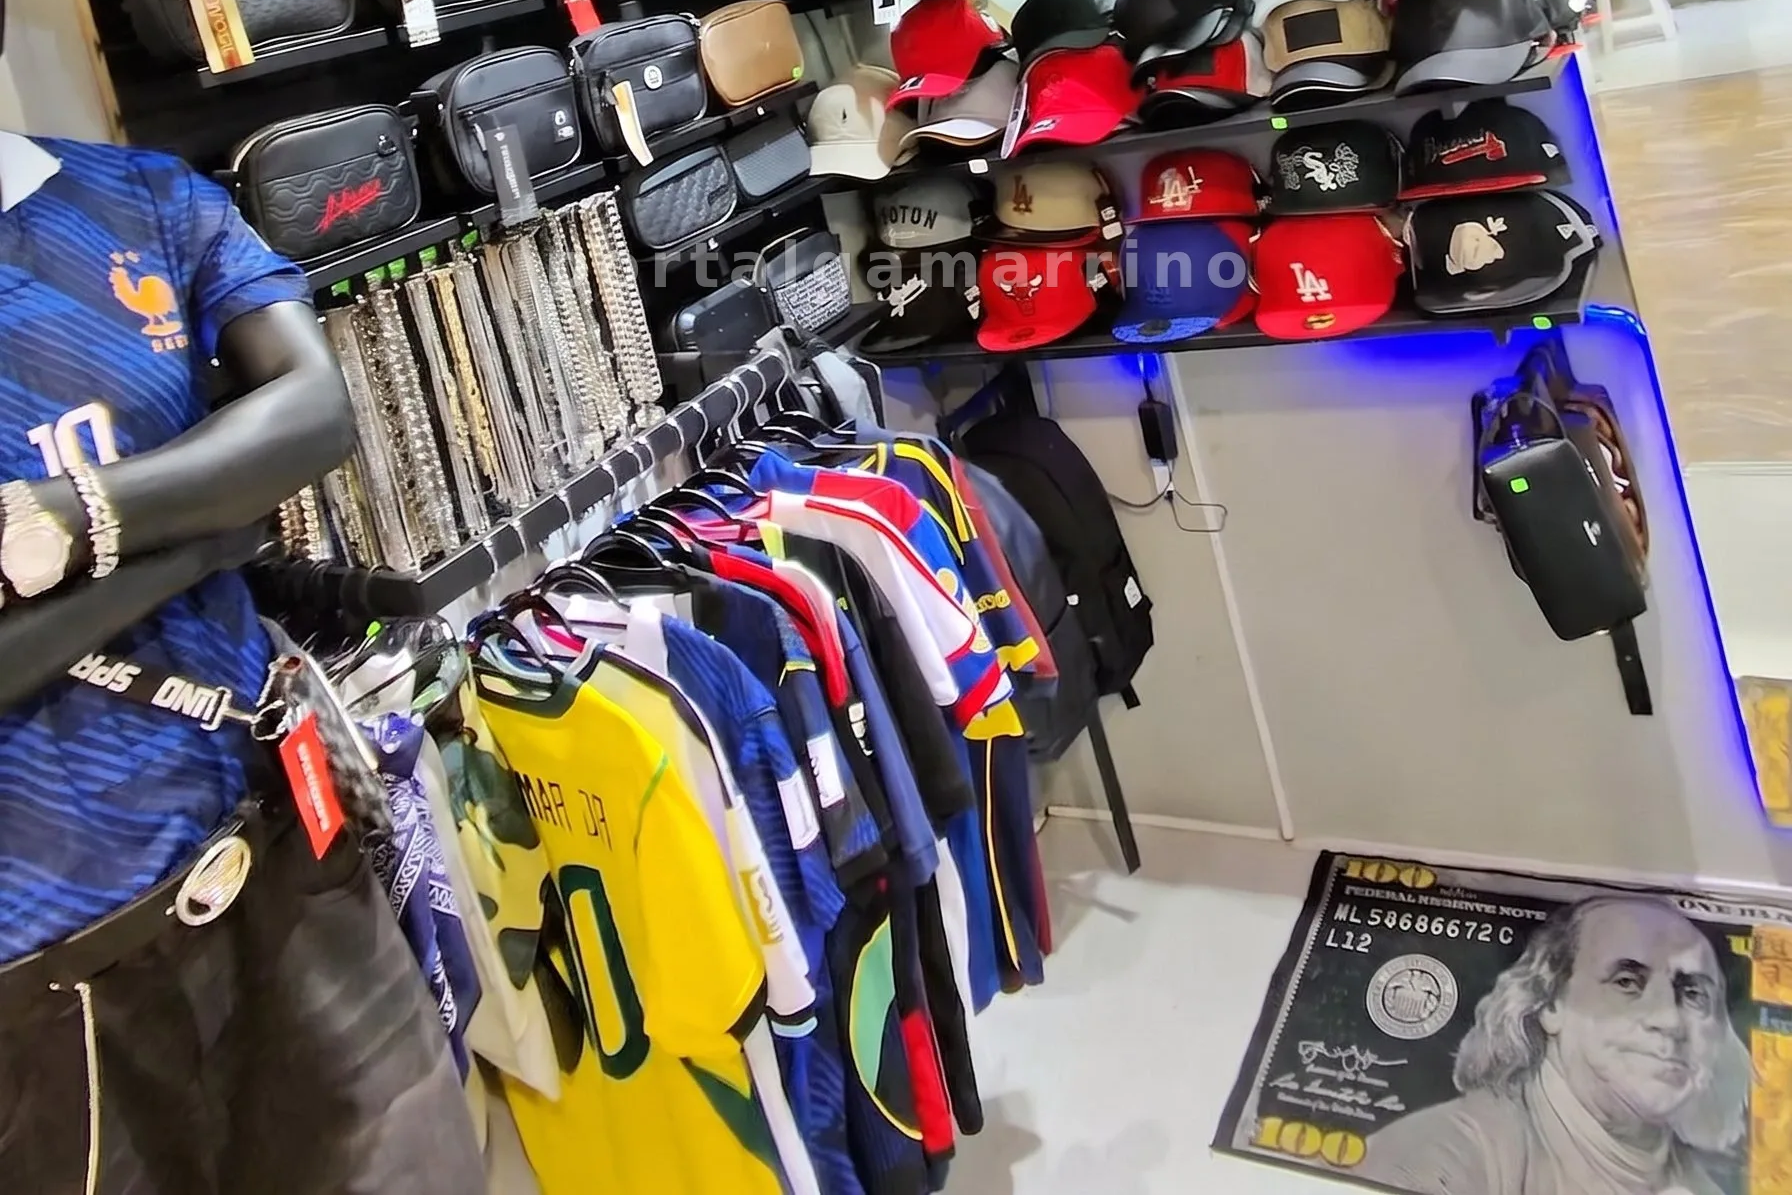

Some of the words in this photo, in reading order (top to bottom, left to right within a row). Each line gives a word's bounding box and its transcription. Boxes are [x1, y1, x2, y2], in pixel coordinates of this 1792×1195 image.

[1013, 174, 1034, 213] LA
[1289, 261, 1332, 303] LA
[1341, 858, 1438, 890] 100
[1325, 927, 1373, 954] L12
[1333, 902, 1362, 925] ML
[1498, 925, 1514, 946] C
